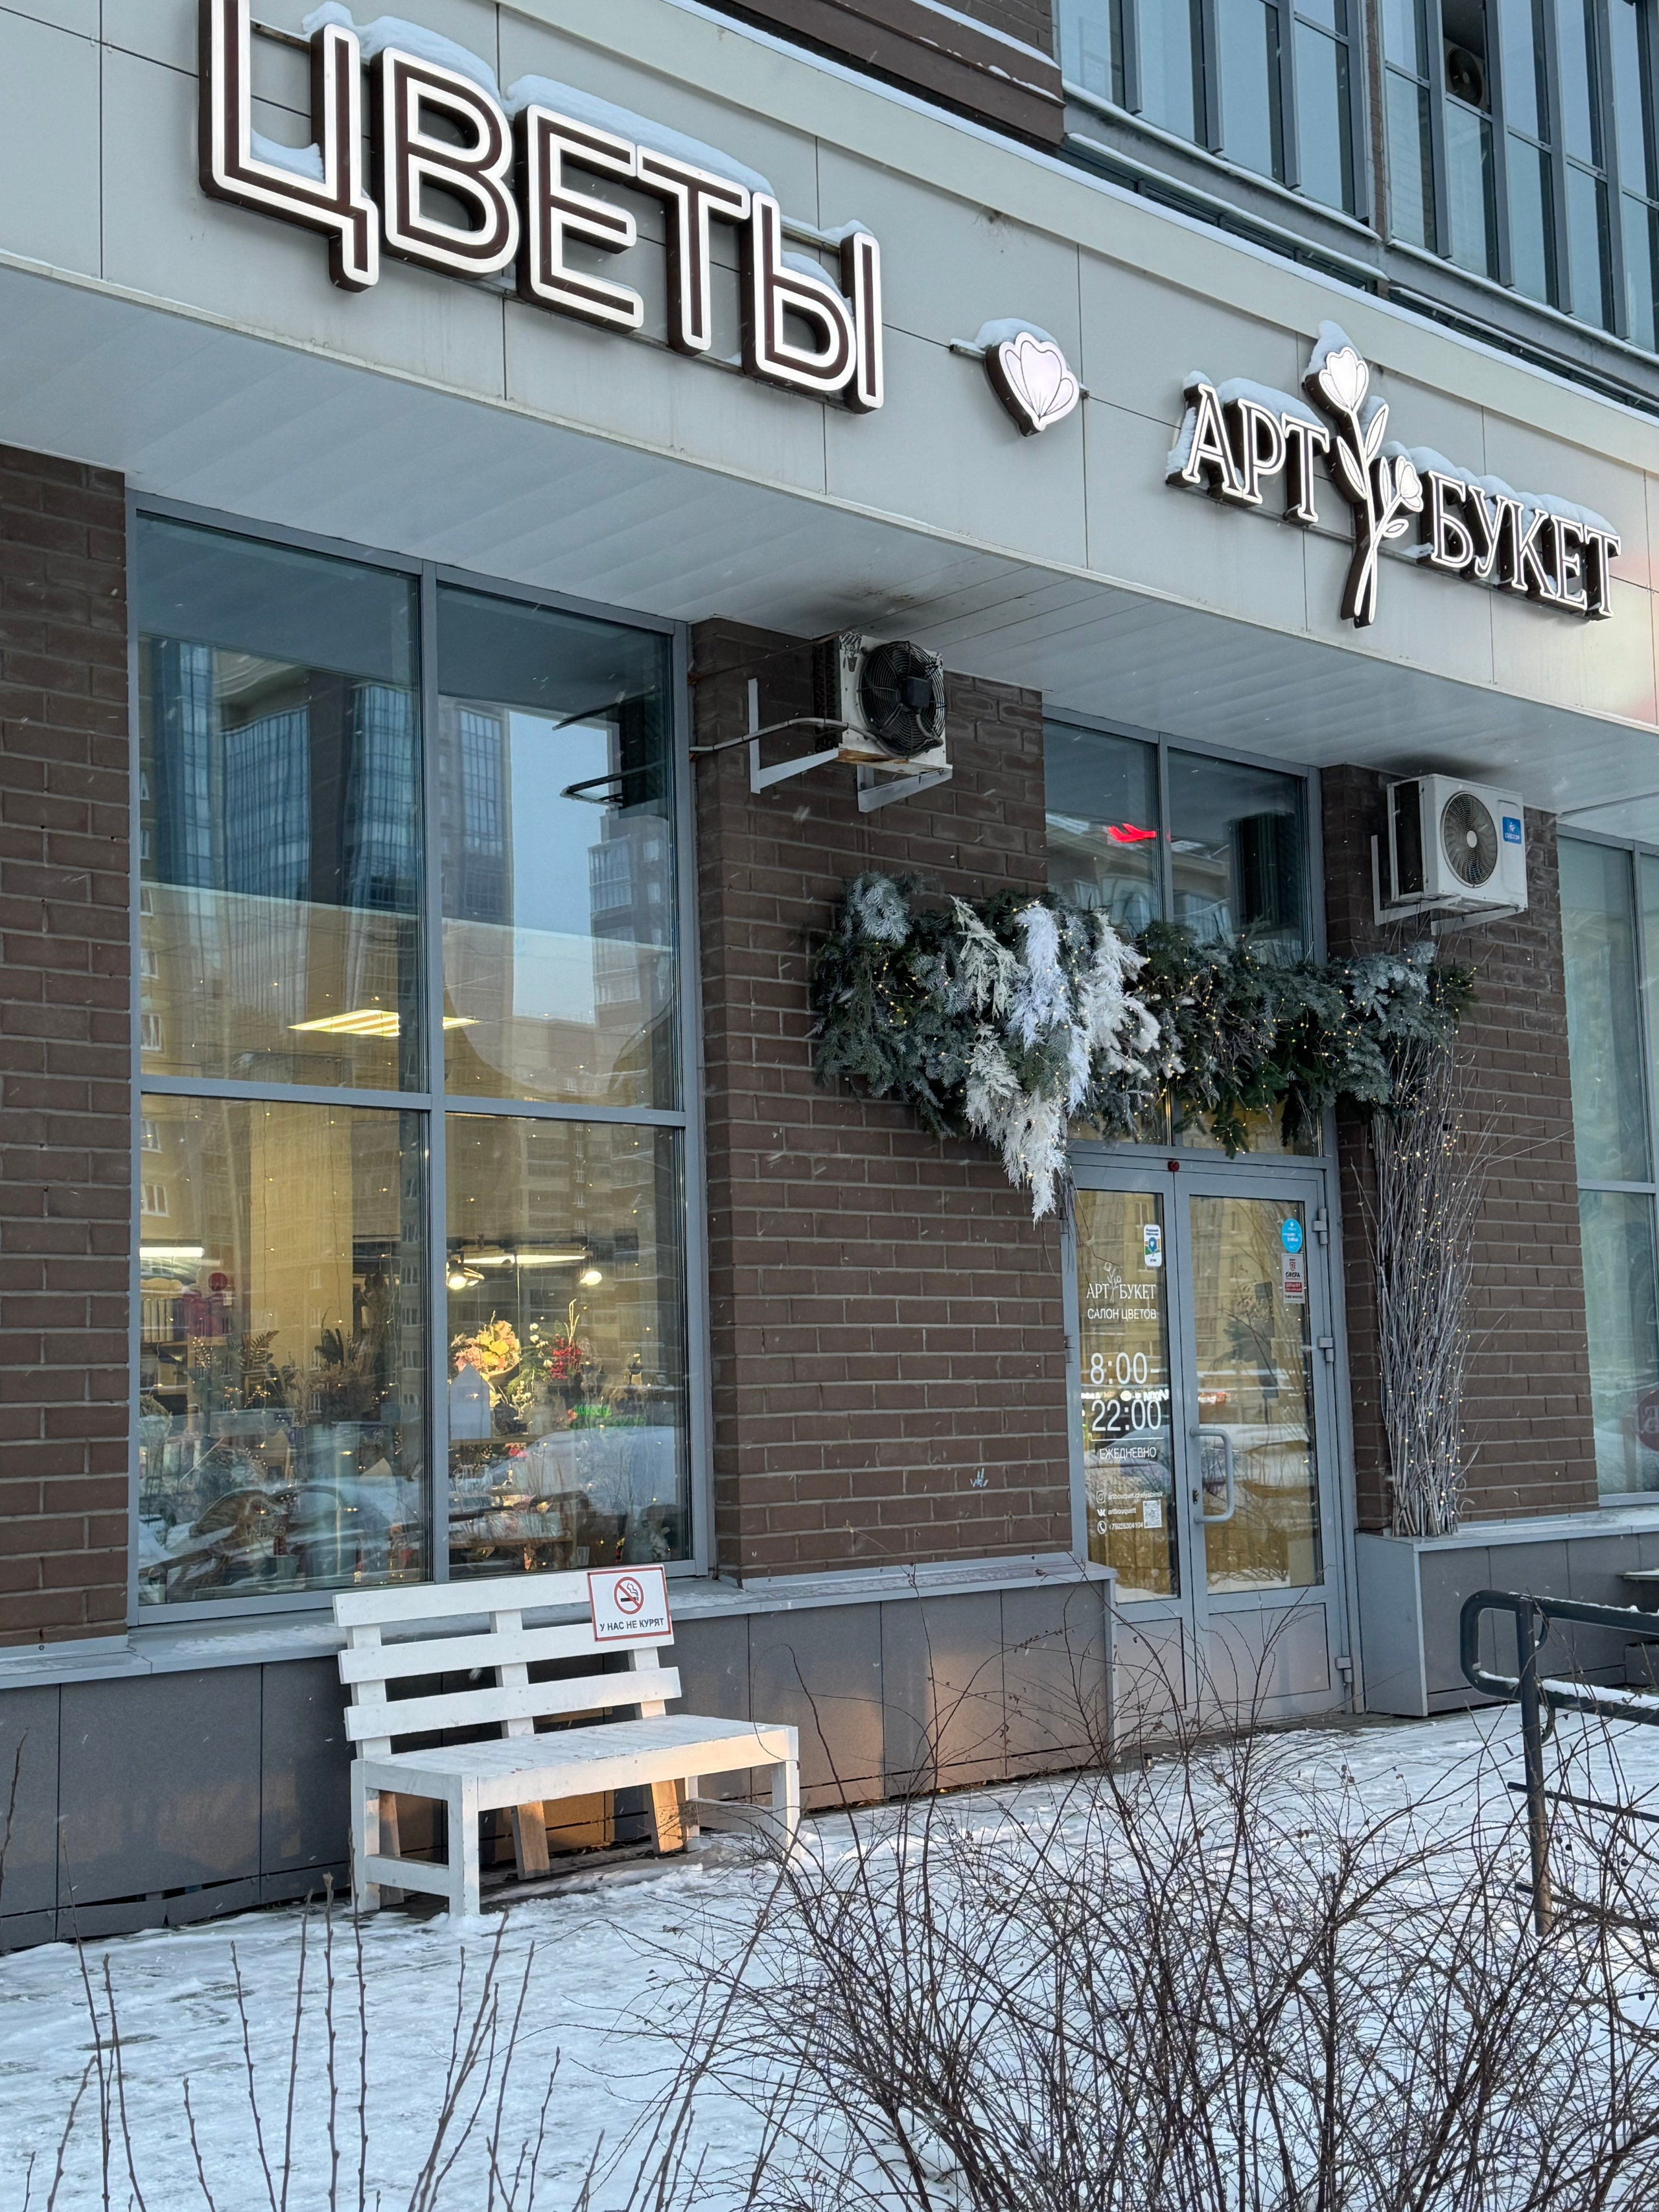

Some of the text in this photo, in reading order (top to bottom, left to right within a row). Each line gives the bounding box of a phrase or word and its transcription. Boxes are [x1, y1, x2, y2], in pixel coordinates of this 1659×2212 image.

[199, 0, 883, 413] ЦВЕТЫ
[1173, 382, 1621, 619] АРТ БУКЕТ
[1086, 1283, 1157, 1299] АРТ БУКЕТ
[1087, 1308, 1157, 1321] САЛОН ЦВЕТОВ
[1091, 1399, 1162, 1431] 22:00
[1099, 1447, 1157, 1460] ЕЖЕДНЕВНО
[599, 1618, 664, 1632] У НАС НЕ КУРЯТ
